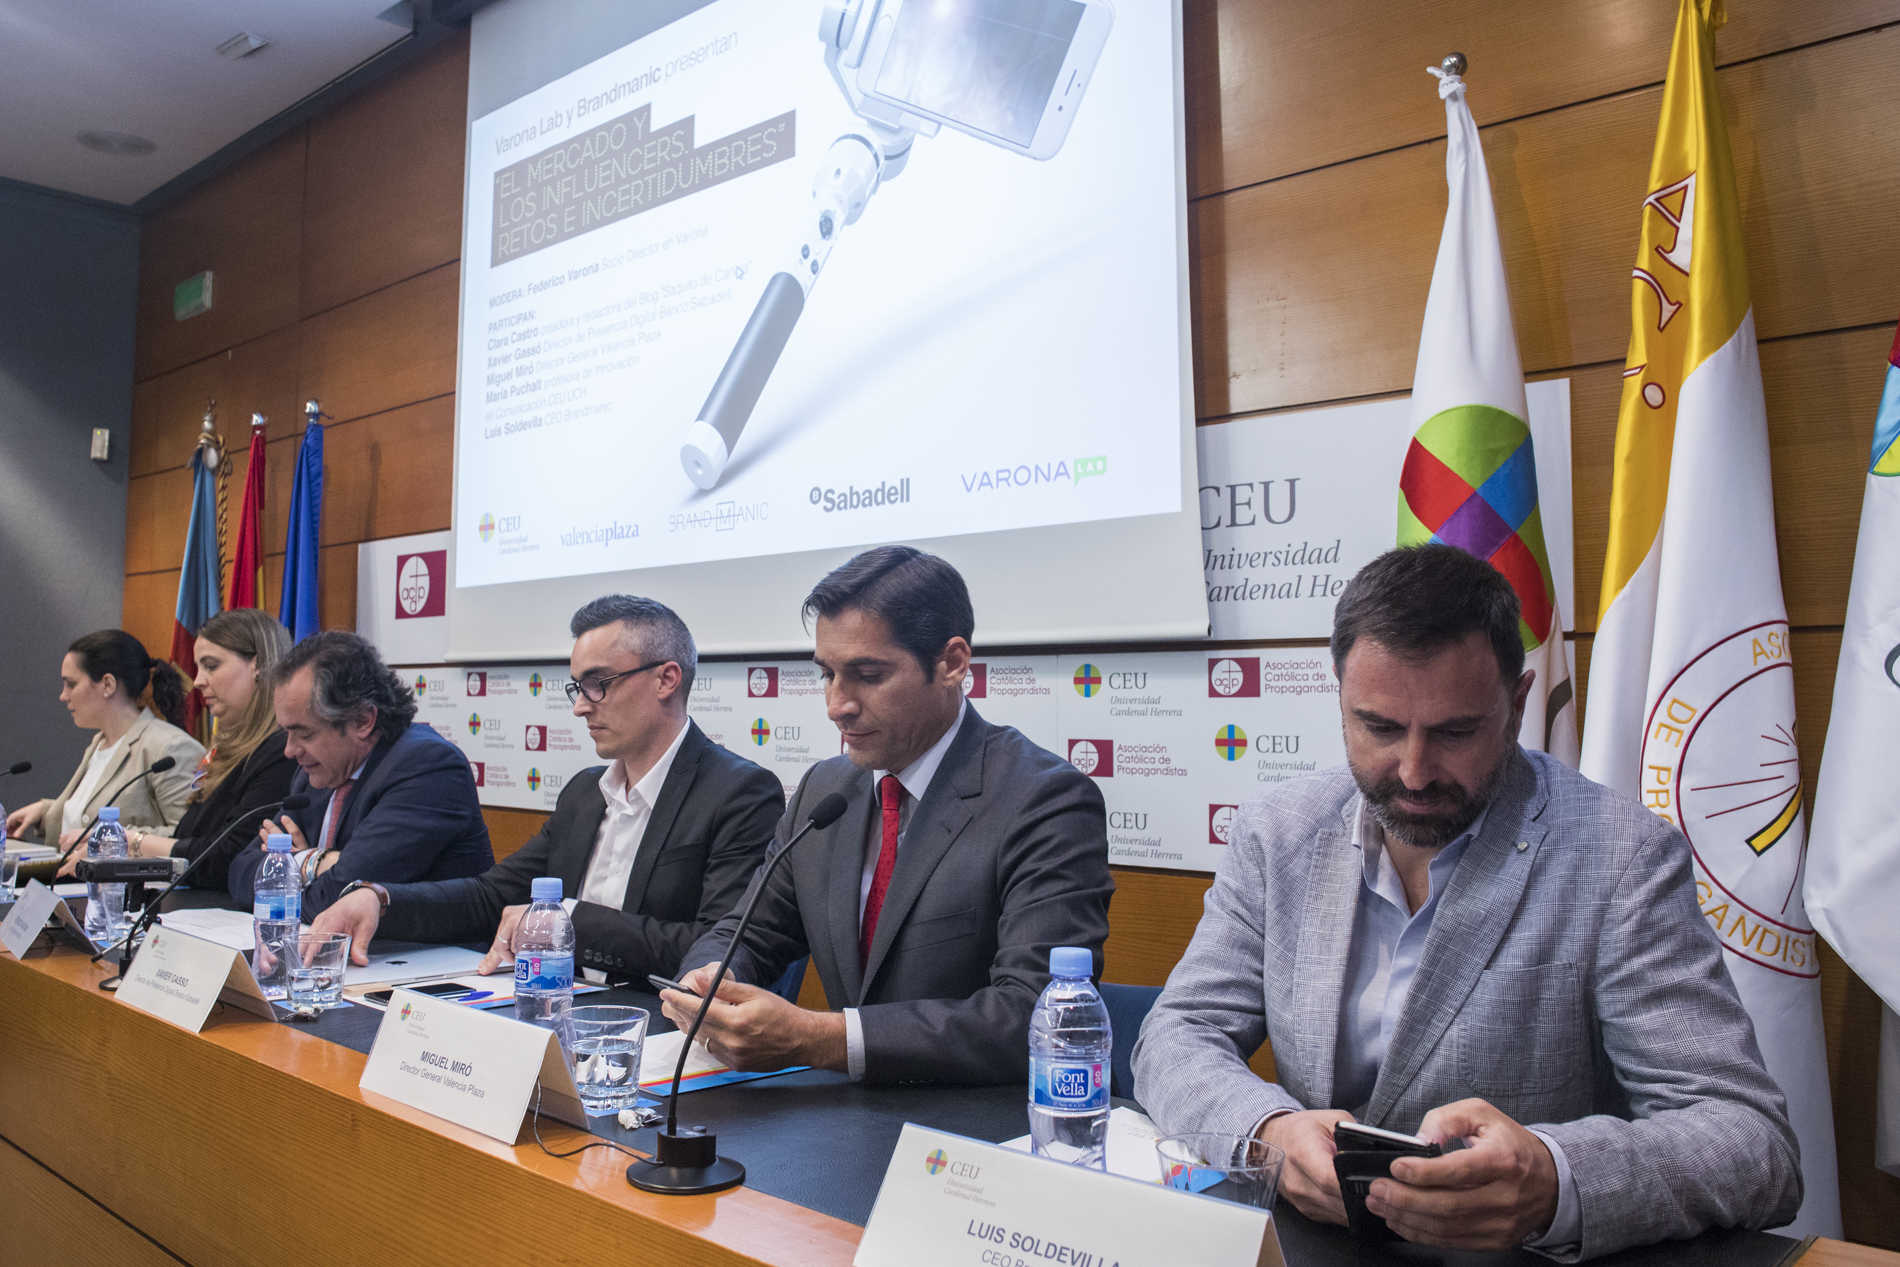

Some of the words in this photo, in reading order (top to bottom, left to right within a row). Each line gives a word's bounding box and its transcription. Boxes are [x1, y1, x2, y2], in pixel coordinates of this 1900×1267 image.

[495, 125, 537, 155] Varona
[538, 114, 563, 136] Lab
[565, 108, 575, 128] y
[576, 66, 661, 118] Brandmanic
[664, 31, 738, 79] presentan
[527, 123, 627, 187] MERCADO
[633, 112, 649, 140] Y
[499, 192, 537, 227] LOS
[499, 215, 558, 257] RETOS
[564, 207, 576, 232] E
[567, 263, 600, 281] Varona
[961, 461, 1071, 493] VARONA
[822, 477, 911, 513] Sabadell
[1199, 477, 1301, 531] CEU
[498, 514, 521, 534] CEU
[1206, 575, 1301, 603] ardenal
[990, 665, 1033, 675] Asociación
[1264, 660, 1322, 671] Asociación
[990, 676, 1023, 685] Católica
[1025, 676, 1037, 685] de
[1108, 672, 1147, 690] CEU
[1264, 672, 1312, 682] Católica
[1313, 672, 1326, 682] de
[990, 686, 1051, 697] Propagandistas
[1264, 683, 1341, 696] Propagandista
[1653, 697, 1698, 749] DE
[774, 726, 801, 741] CEU
[1117, 744, 1167, 754] Asociación
[1256, 734, 1300, 754] CEU
[1117, 754, 1156, 765] Católica
[1158, 755, 1171, 765] de
[1257, 760, 1317, 771] Universidad
[1117, 765, 1188, 778] Propagandistas
[1109, 811, 1149, 830] CEU
[420, 1050, 450, 1071] MIGUEL
[451, 1060, 473, 1077] MIRÓ
[399, 1061, 420, 1078] Director
[420, 1067, 443, 1085] General
[443, 1075, 468, 1093] Valencia
[467, 1083, 486, 1099] Plaza
[1055, 1069, 1085, 1083] Font
[1055, 1082, 1086, 1096] Vella
[951, 1160, 981, 1180] CEU
[967, 1219, 1006, 1244] LUIS
[982, 1249, 1012, 1267] CEO
